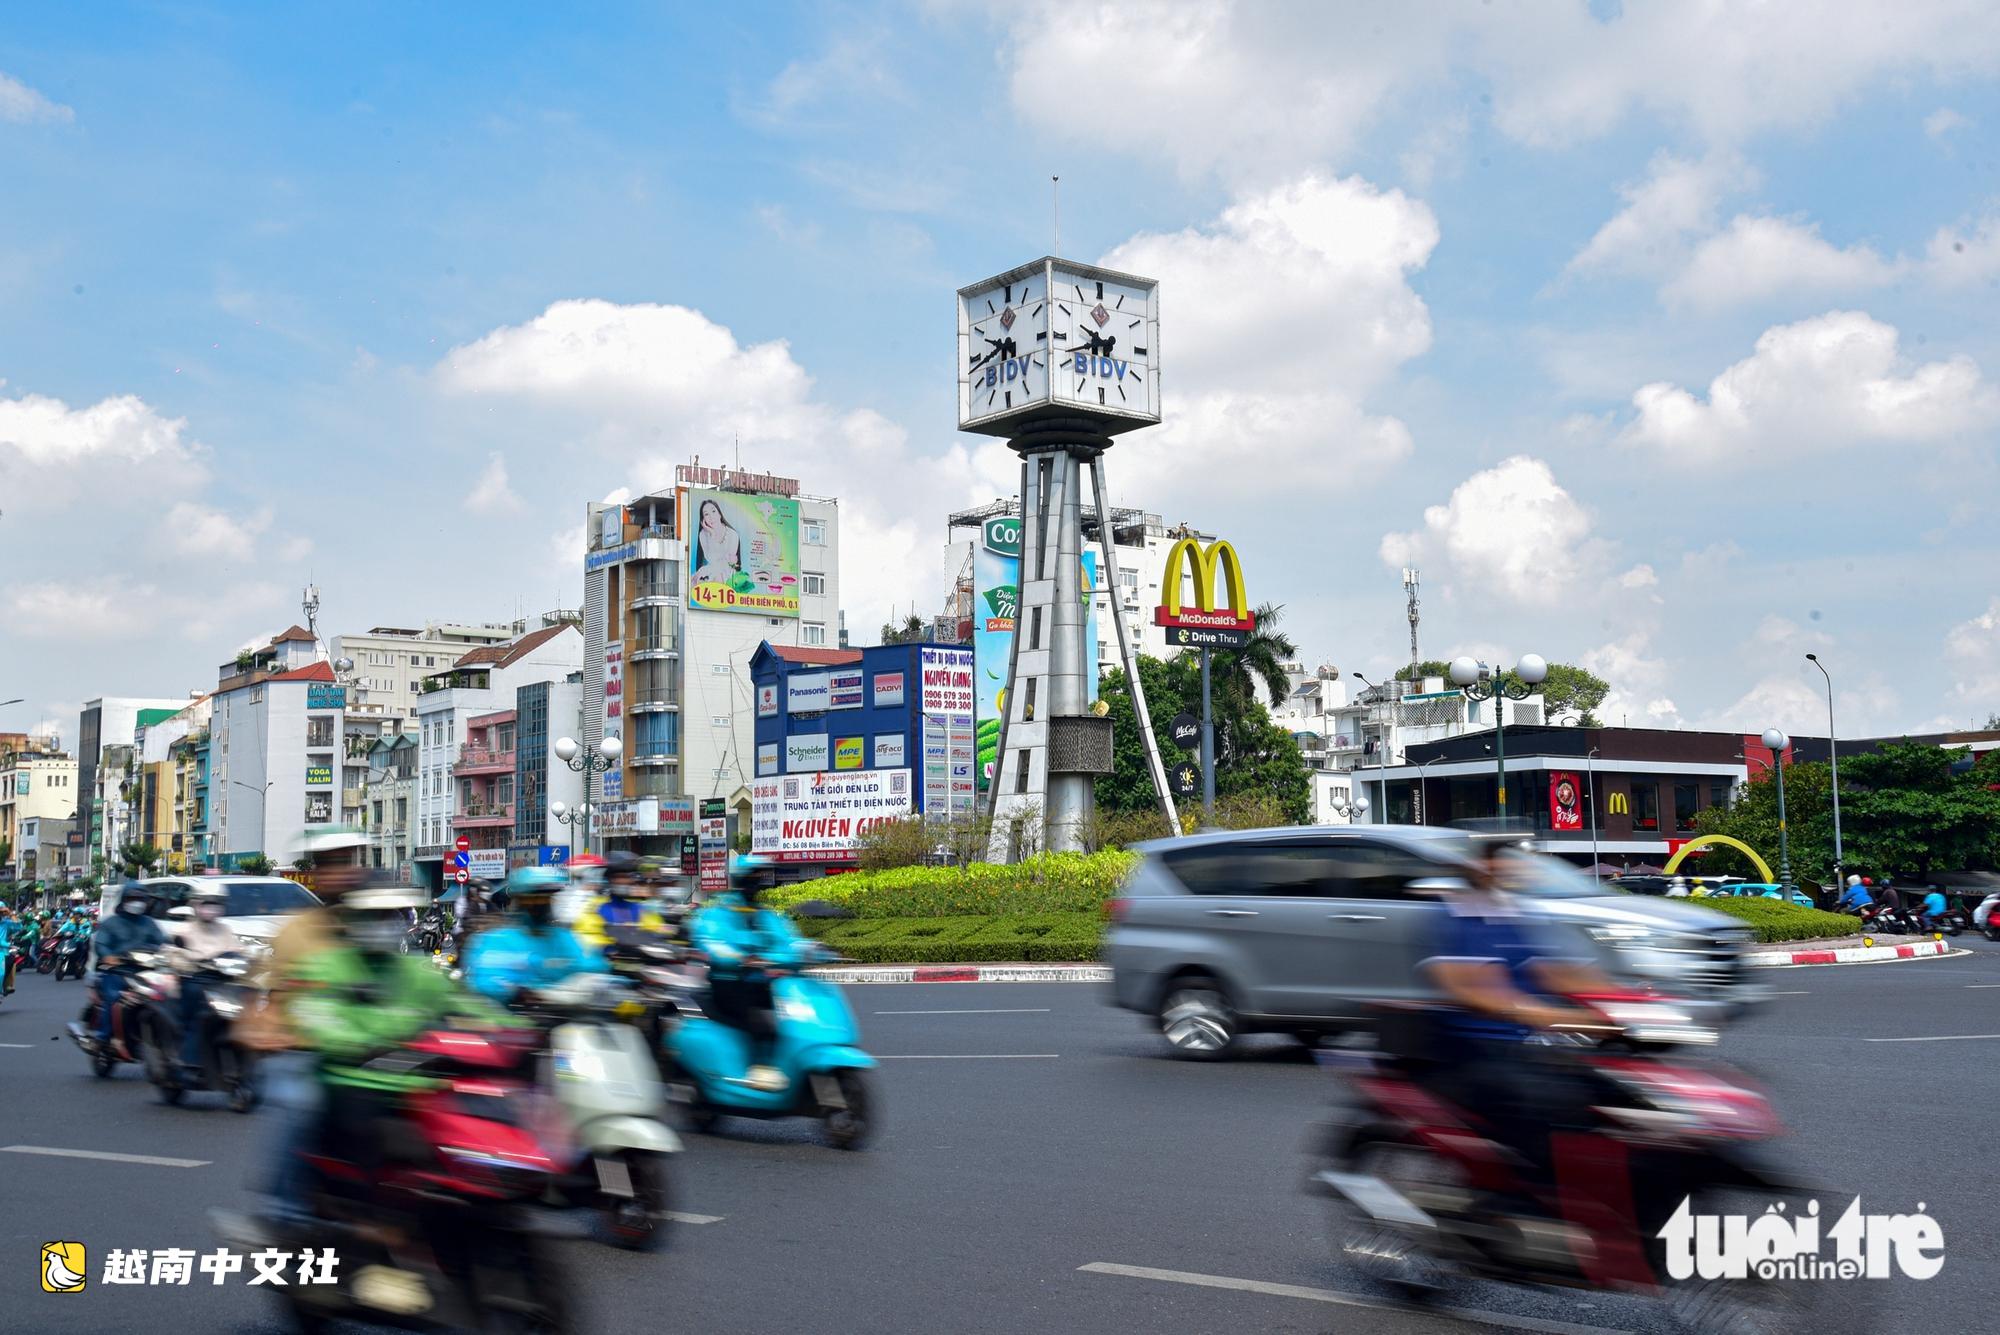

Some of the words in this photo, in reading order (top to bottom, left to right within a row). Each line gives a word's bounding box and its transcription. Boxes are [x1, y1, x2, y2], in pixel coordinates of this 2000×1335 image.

[986, 355, 1031, 387] BIDV
[1074, 352, 1128, 381] BIDV
[991, 523, 1020, 543] Co
[694, 586, 735, 604] 14-16
[740, 596, 755, 606] ĐIỆN
[1179, 613, 1237, 627] McDonald's
[1191, 631, 1217, 643] Drive
[1218, 632, 1238, 644] Thru
[952, 671, 972, 688] GIANG
[789, 685, 828, 697] Panasonic
[875, 684, 902, 693] CADIVI
[924, 690, 942, 699] 0906
[943, 691, 957, 700] 679
[957, 692, 972, 700] 300
[924, 699, 942, 709] 0909
[944, 700, 957, 709] 209
[958, 701, 972, 710] 300
[788, 746, 827, 760] Schneider
[837, 747, 860, 756] MPE
[953, 765, 967, 775] LS
[811, 783, 825, 795] THẾ
[827, 783, 844, 794] GIỚI
[864, 783, 879, 792] LED
[1181, 783, 1194, 791] 24/7
[784, 800, 809, 811] TRUNG
[810, 798, 827, 810] TÂM
[829, 796, 851, 809] THIẾT
[854, 798, 862, 811] BỊ
[864, 798, 882, 810] ĐIỆN
[885, 793, 907, 806] NƯỚC
[660, 808, 677, 821] HOÀI
[678, 809, 693, 821] ANH
[782, 811, 851, 839] NGUYỄN
